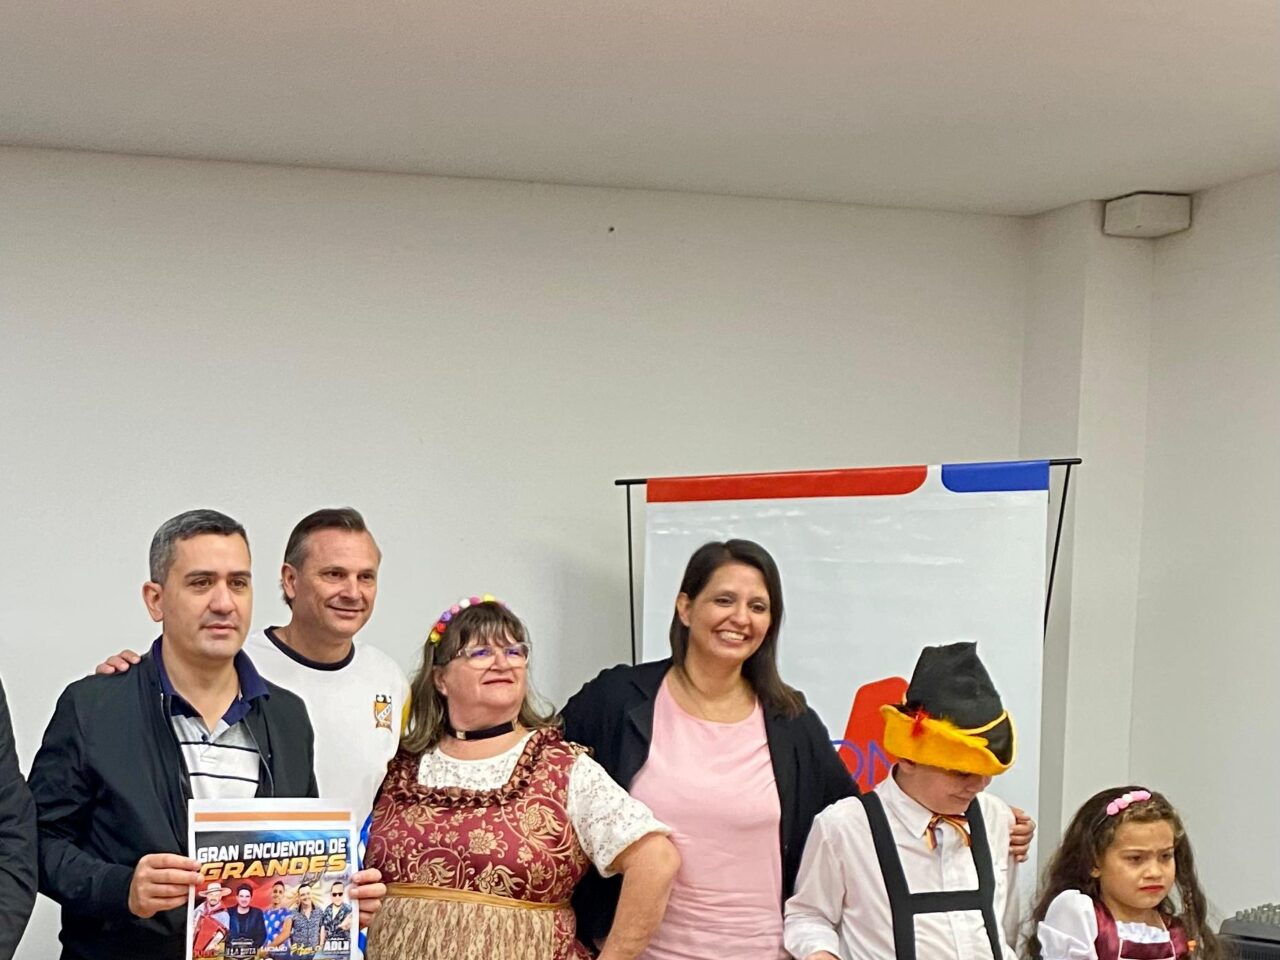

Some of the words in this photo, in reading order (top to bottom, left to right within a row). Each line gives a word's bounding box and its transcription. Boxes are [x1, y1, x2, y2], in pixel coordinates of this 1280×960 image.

[197, 844, 239, 862] GRAN
[243, 839, 325, 860] ENCUENTRO
[328, 837, 347, 854] DE
[199, 853, 347, 881] GRANDES
